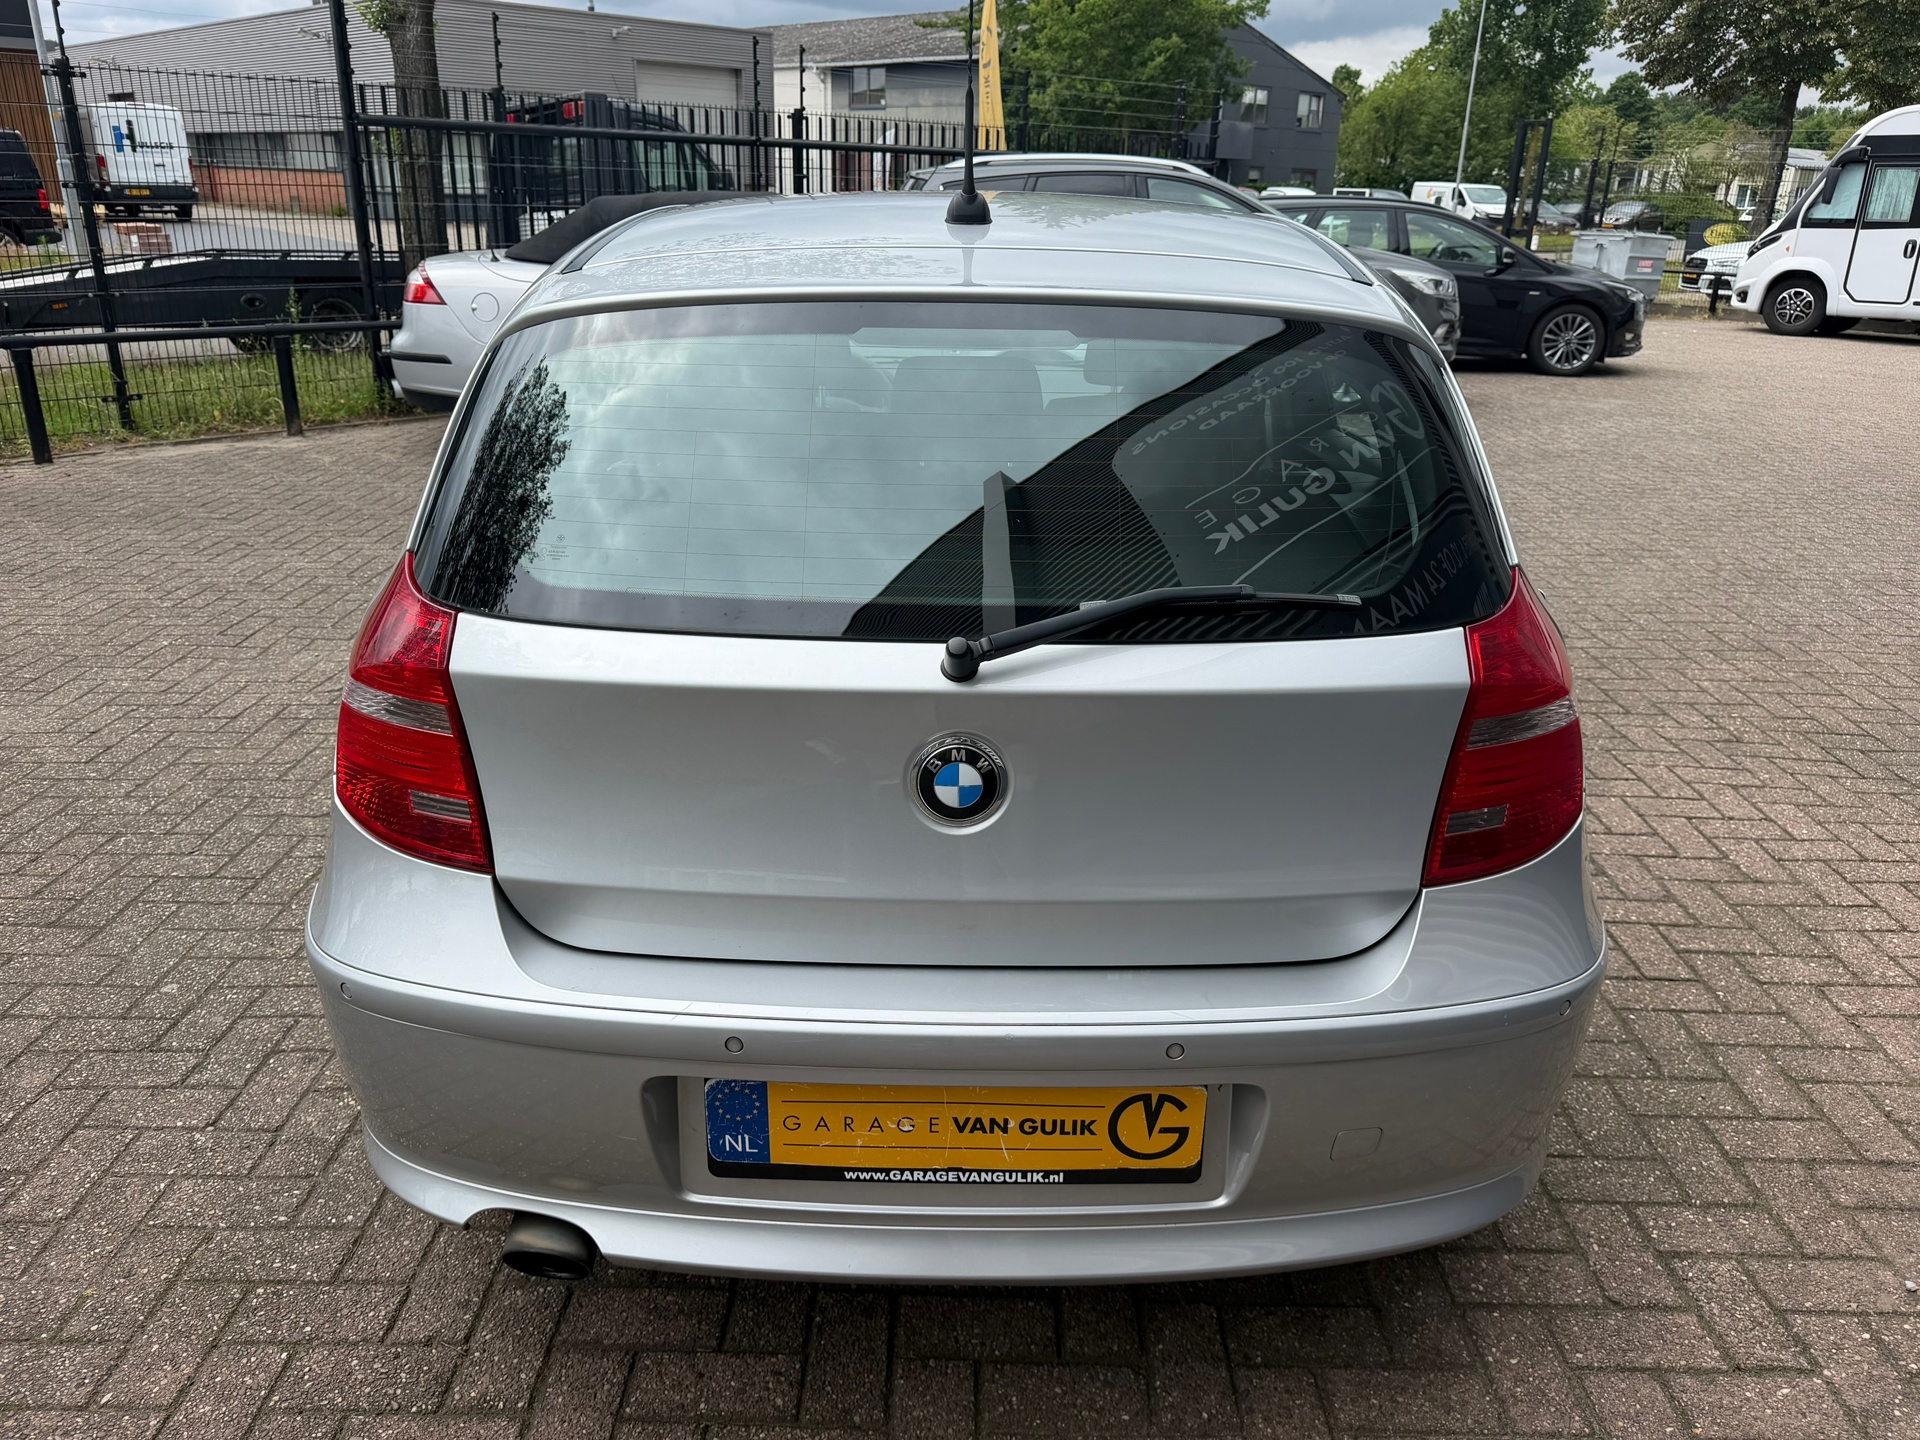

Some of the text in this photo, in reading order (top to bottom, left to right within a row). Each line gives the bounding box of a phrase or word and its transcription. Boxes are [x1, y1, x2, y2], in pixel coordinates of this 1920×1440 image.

[926, 749, 993, 774] BMW
[782, 1115, 1098, 1136] GARAGE VAN GULIK
[724, 1134, 759, 1153] NL
[844, 1170, 1064, 1183] www.GARAGEVANGULIK.nl
